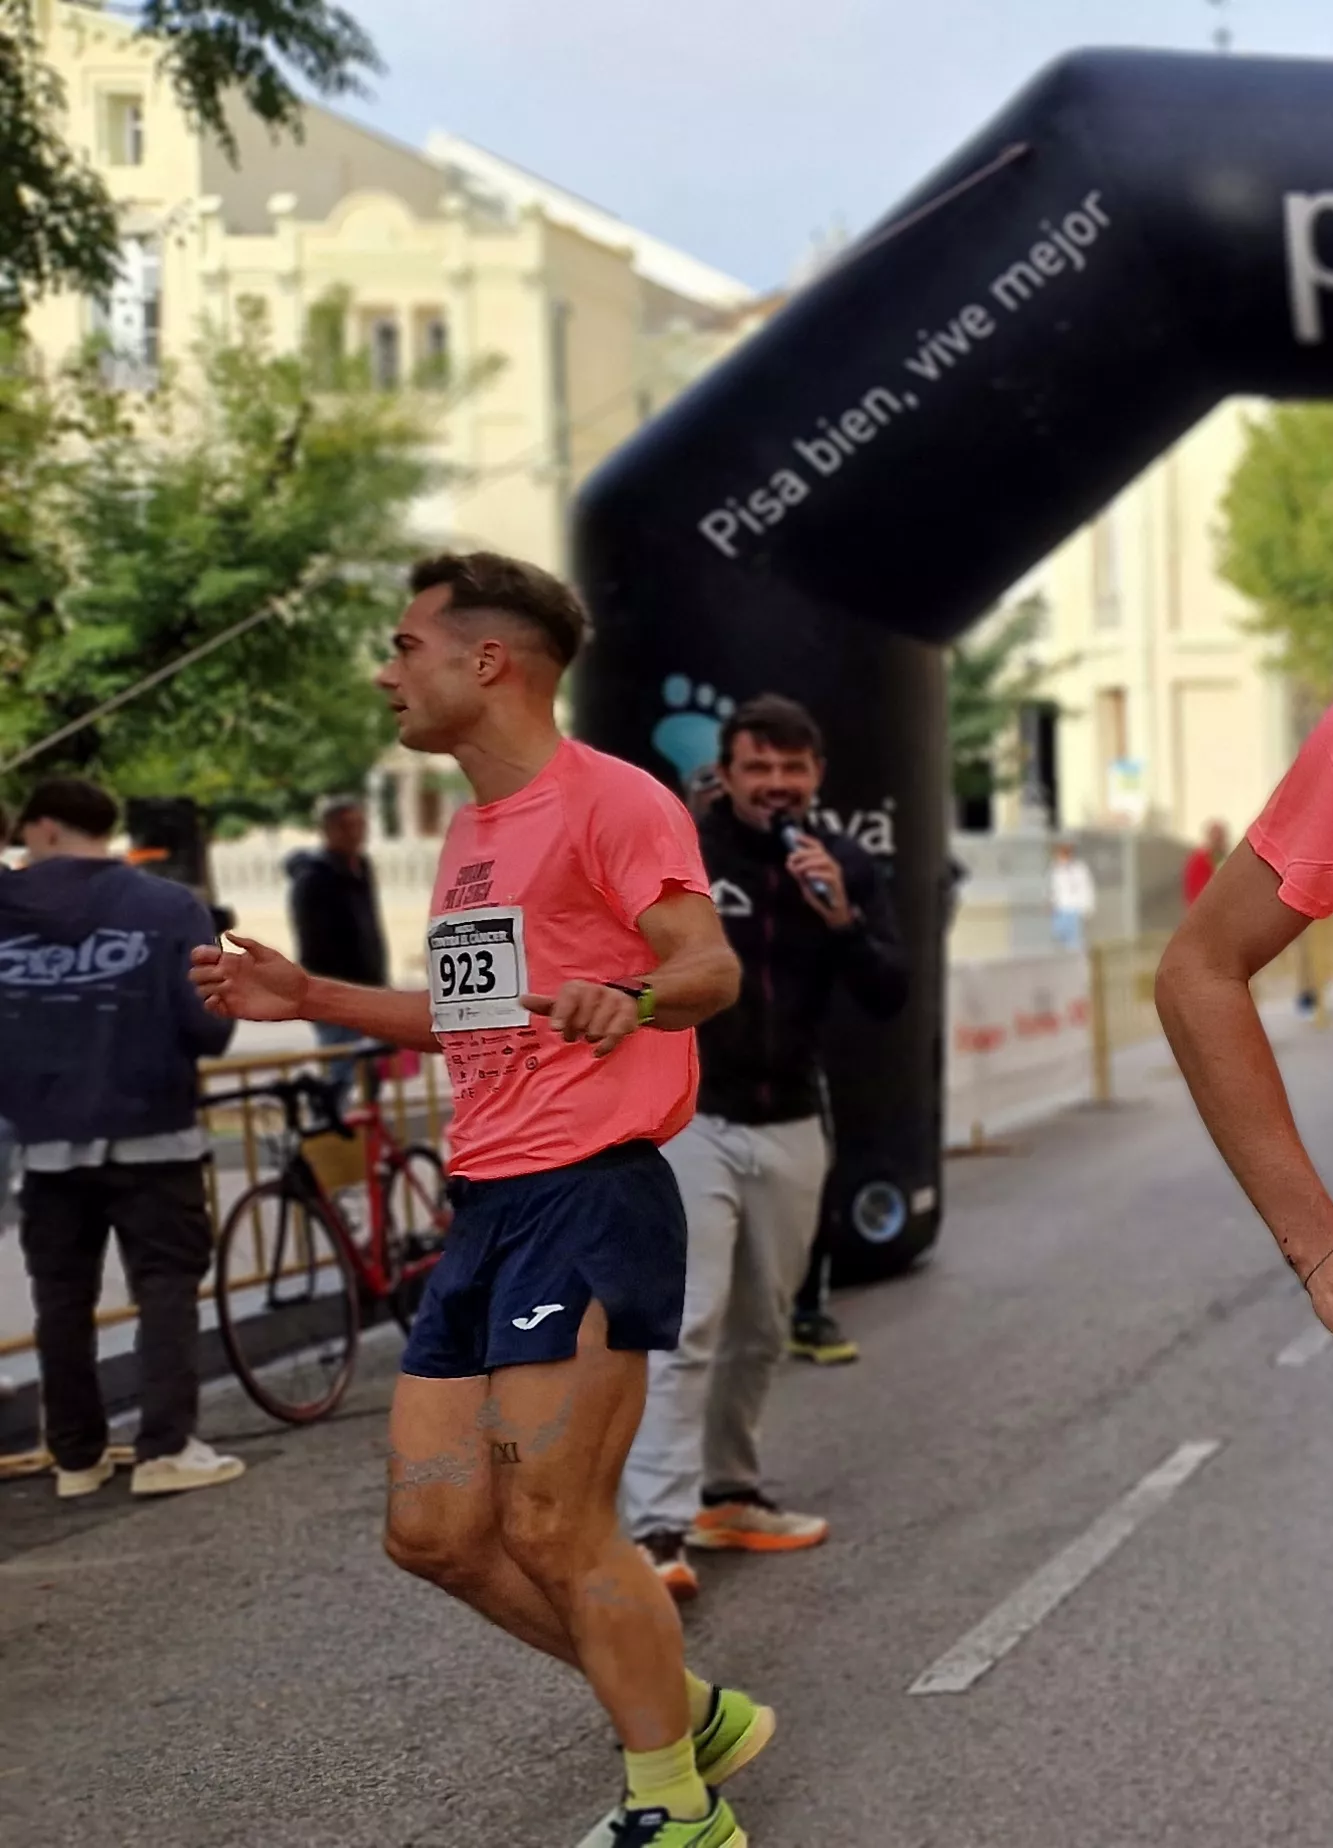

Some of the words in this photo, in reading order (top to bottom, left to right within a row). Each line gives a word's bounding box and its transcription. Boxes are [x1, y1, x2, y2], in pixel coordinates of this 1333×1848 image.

[698, 467, 811, 558] Pisa
[793, 385, 920, 477] bien,
[904, 303, 997, 381] vive
[989, 189, 1111, 312] mejor
[440, 950, 496, 997] 923
